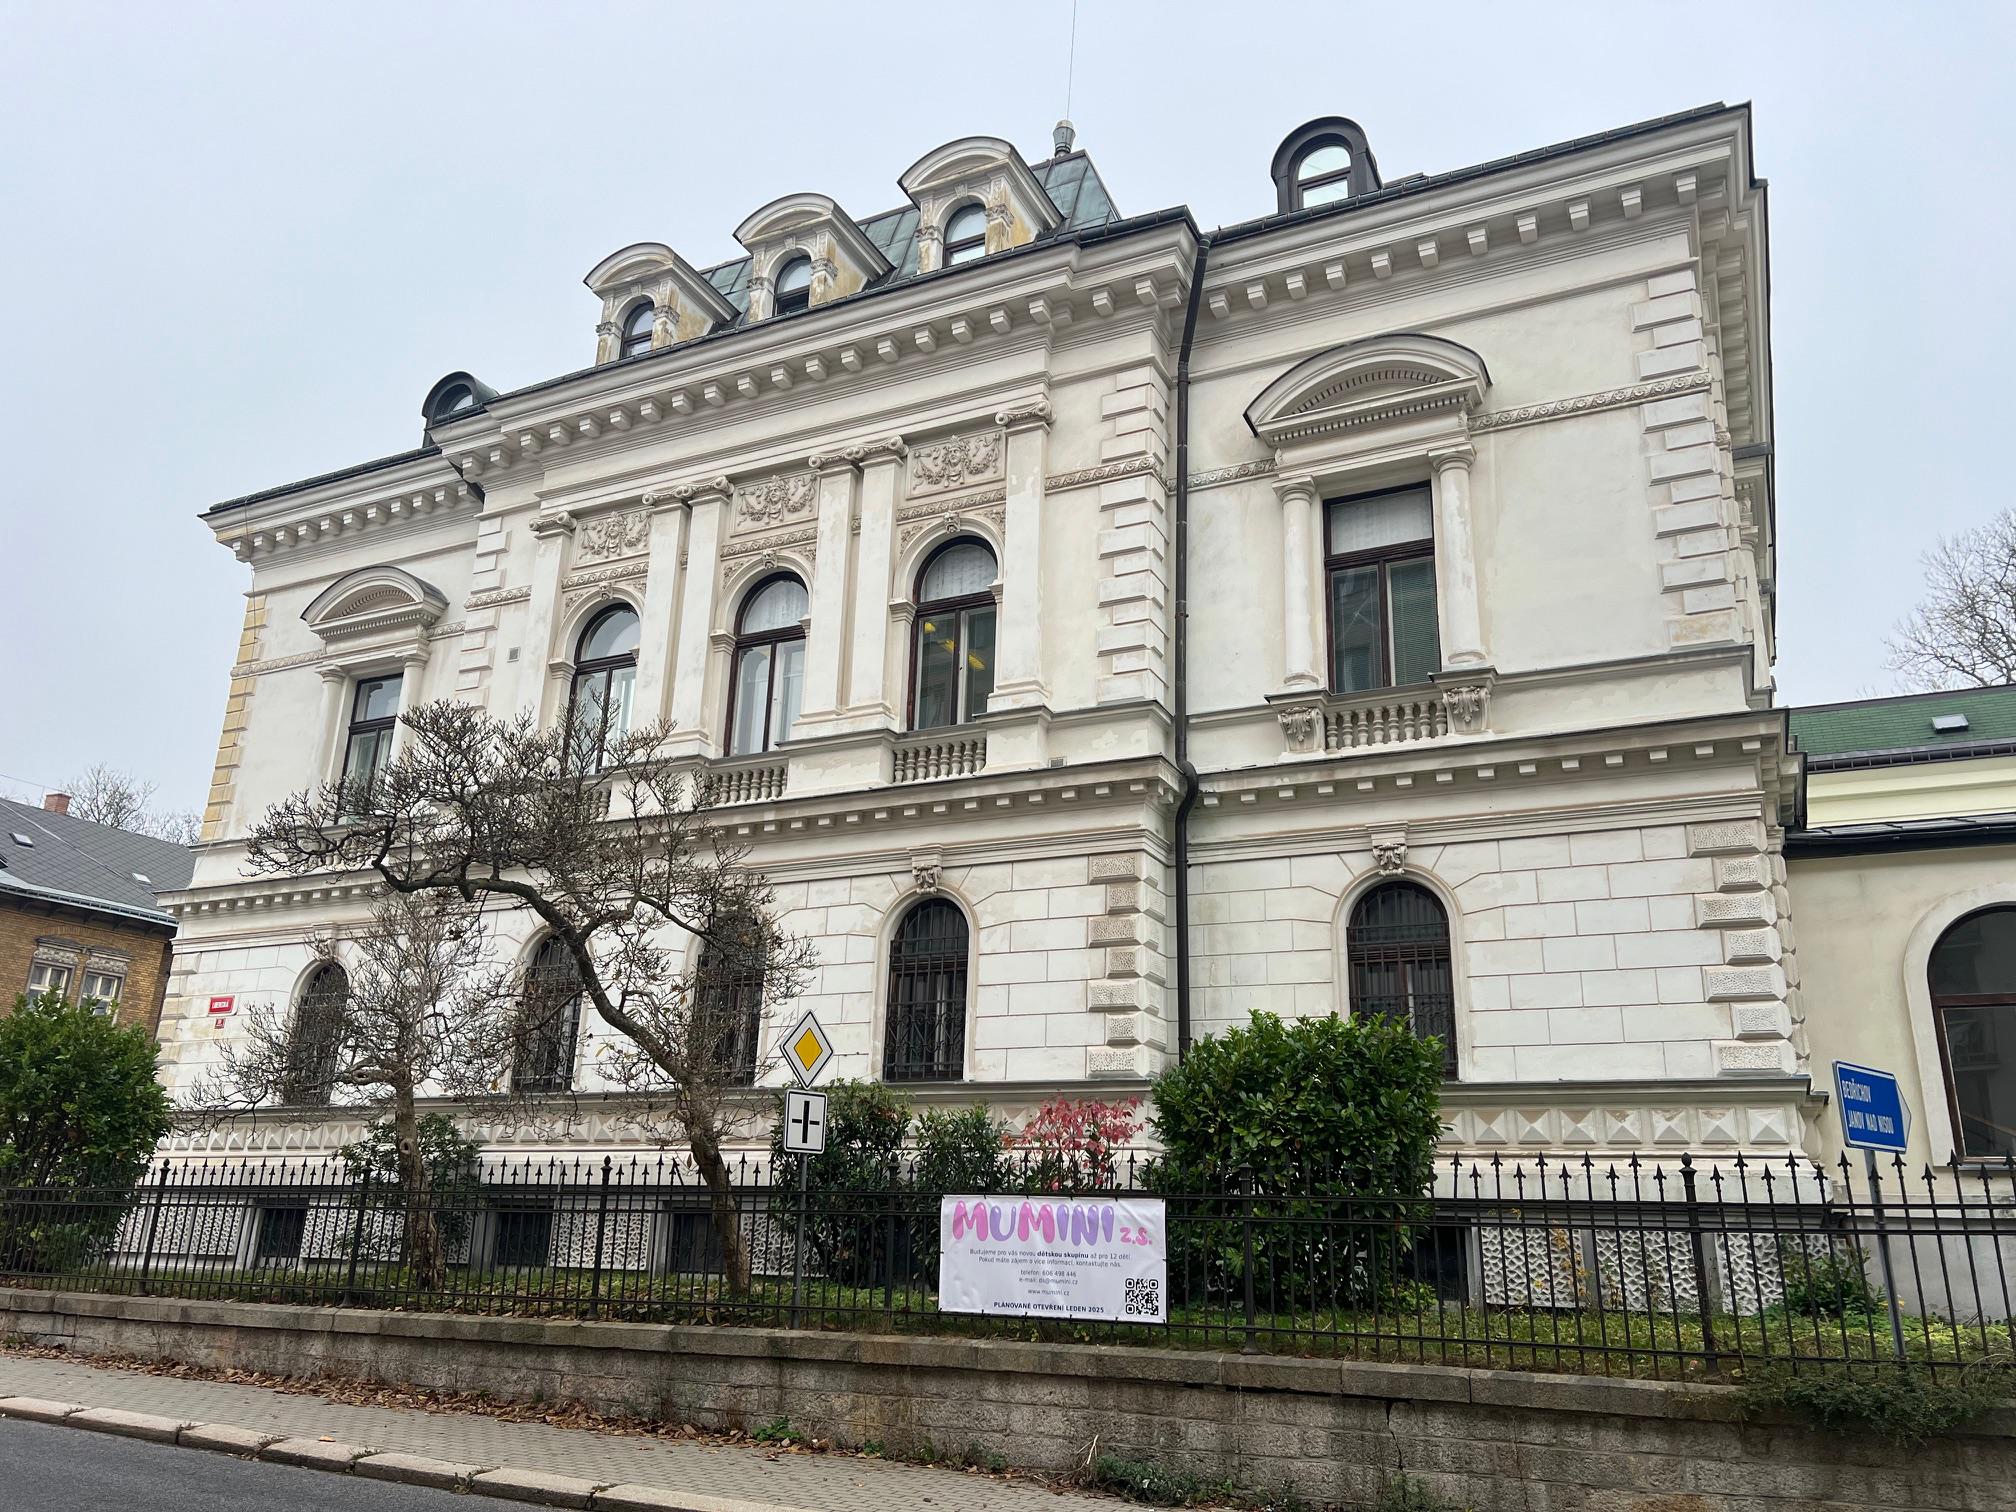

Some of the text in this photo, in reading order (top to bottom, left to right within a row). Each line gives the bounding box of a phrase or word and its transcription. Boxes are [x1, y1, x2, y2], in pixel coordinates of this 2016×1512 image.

[1841, 1078, 1871, 1103] BEDŘICHOV
[1848, 1109, 1865, 1130] JANOV
[1865, 1112, 1878, 1132] NAD
[953, 1200, 1114, 1246] MUMINI
[970, 1248, 996, 1256] Budujeme
[1011, 1257, 1028, 1265] zájem
[1075, 1260, 1108, 1268] kontaktujte
[993, 1301, 1031, 1309] PLÁNOVANÉ
[1033, 1303, 1064, 1311] OTEVŘENÍ
[1066, 1304, 1087, 1312] LEDEN
